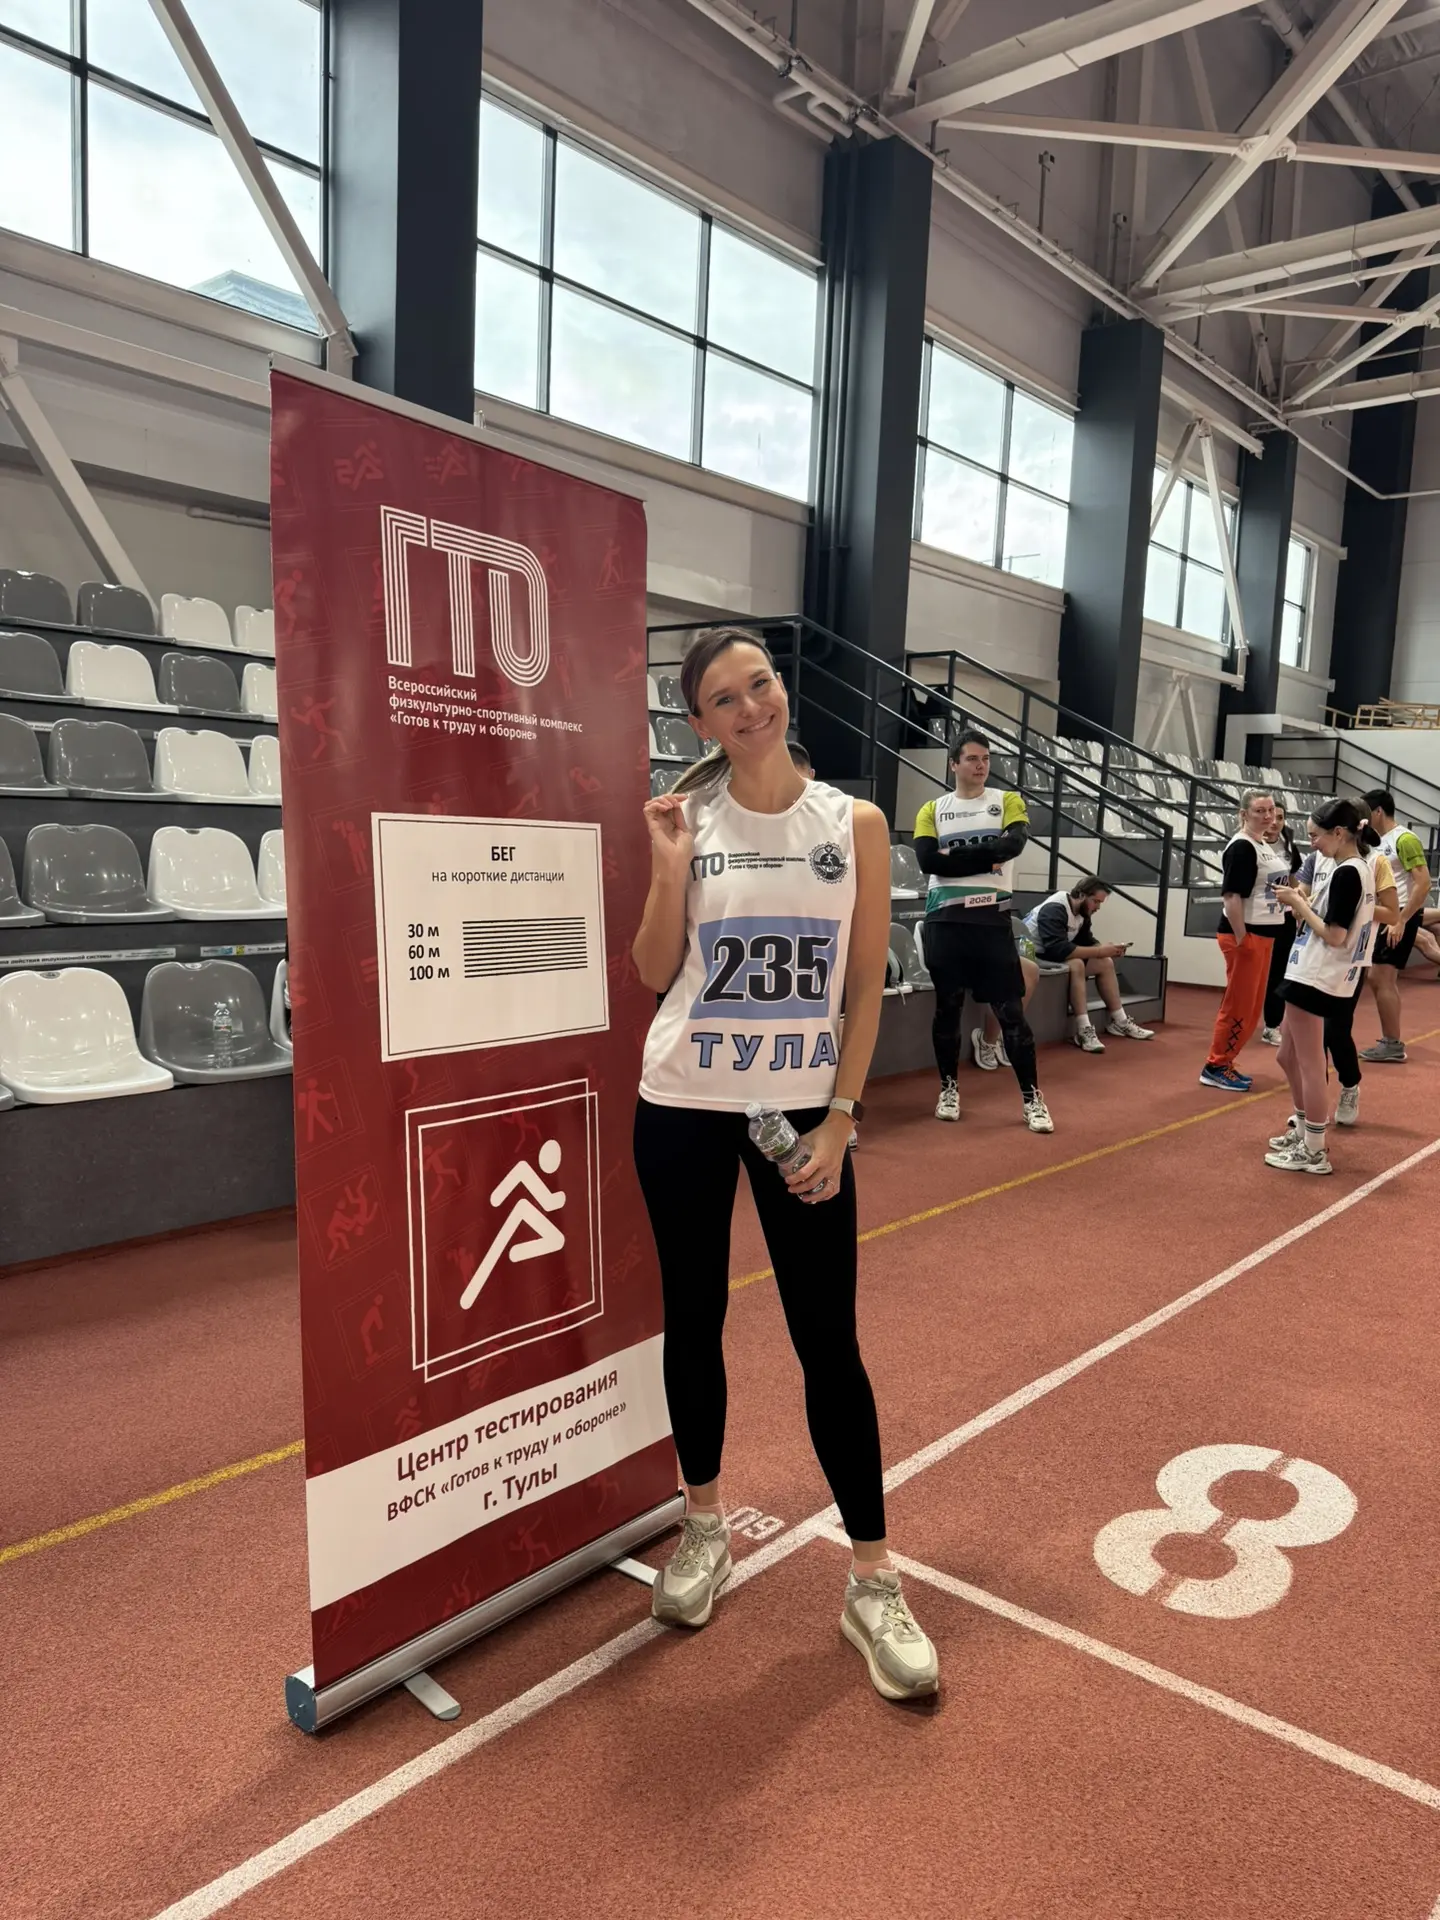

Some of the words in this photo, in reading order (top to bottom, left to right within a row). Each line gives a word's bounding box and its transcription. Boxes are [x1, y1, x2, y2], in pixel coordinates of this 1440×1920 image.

[380, 505, 549, 687] ГТО
[388, 676, 477, 701] Всероссийский
[389, 694, 537, 726] физкультурно-спортивный
[540, 717, 583, 733] комплекс
[390, 711, 430, 728] «Готов
[433, 721, 440, 729] к
[442, 720, 477, 736] труду
[479, 726, 486, 734] и
[489, 725, 538, 741] обороне»
[491, 846, 516, 861] БЕГ
[690, 852, 725, 881] ГТО
[432, 871, 447, 882] на
[451, 871, 507, 884] короткие
[510, 871, 565, 884] дистанции
[969, 896, 992, 905] 2026
[408, 924, 424, 938] 30
[427, 926, 439, 937] м
[408, 945, 424, 959] 60
[428, 947, 440, 958] м
[409, 965, 433, 981] 100
[438, 967, 450, 979] м
[701, 933, 834, 1004] 235
[691, 1032, 837, 1071] ТУЛА
[397, 1432, 468, 1481] Центр
[474, 1370, 618, 1445] тестирования
[387, 1483, 436, 1521] ВФСК
[441, 1461, 489, 1495] «Готов
[494, 1457, 503, 1469] к
[506, 1437, 549, 1467] труду
[553, 1433, 561, 1445] и
[565, 1401, 626, 1440] обороне»
[483, 1492, 498, 1510] г.
[502, 1462, 558, 1500] Тулы
[1093, 1443, 1358, 1620] 8
